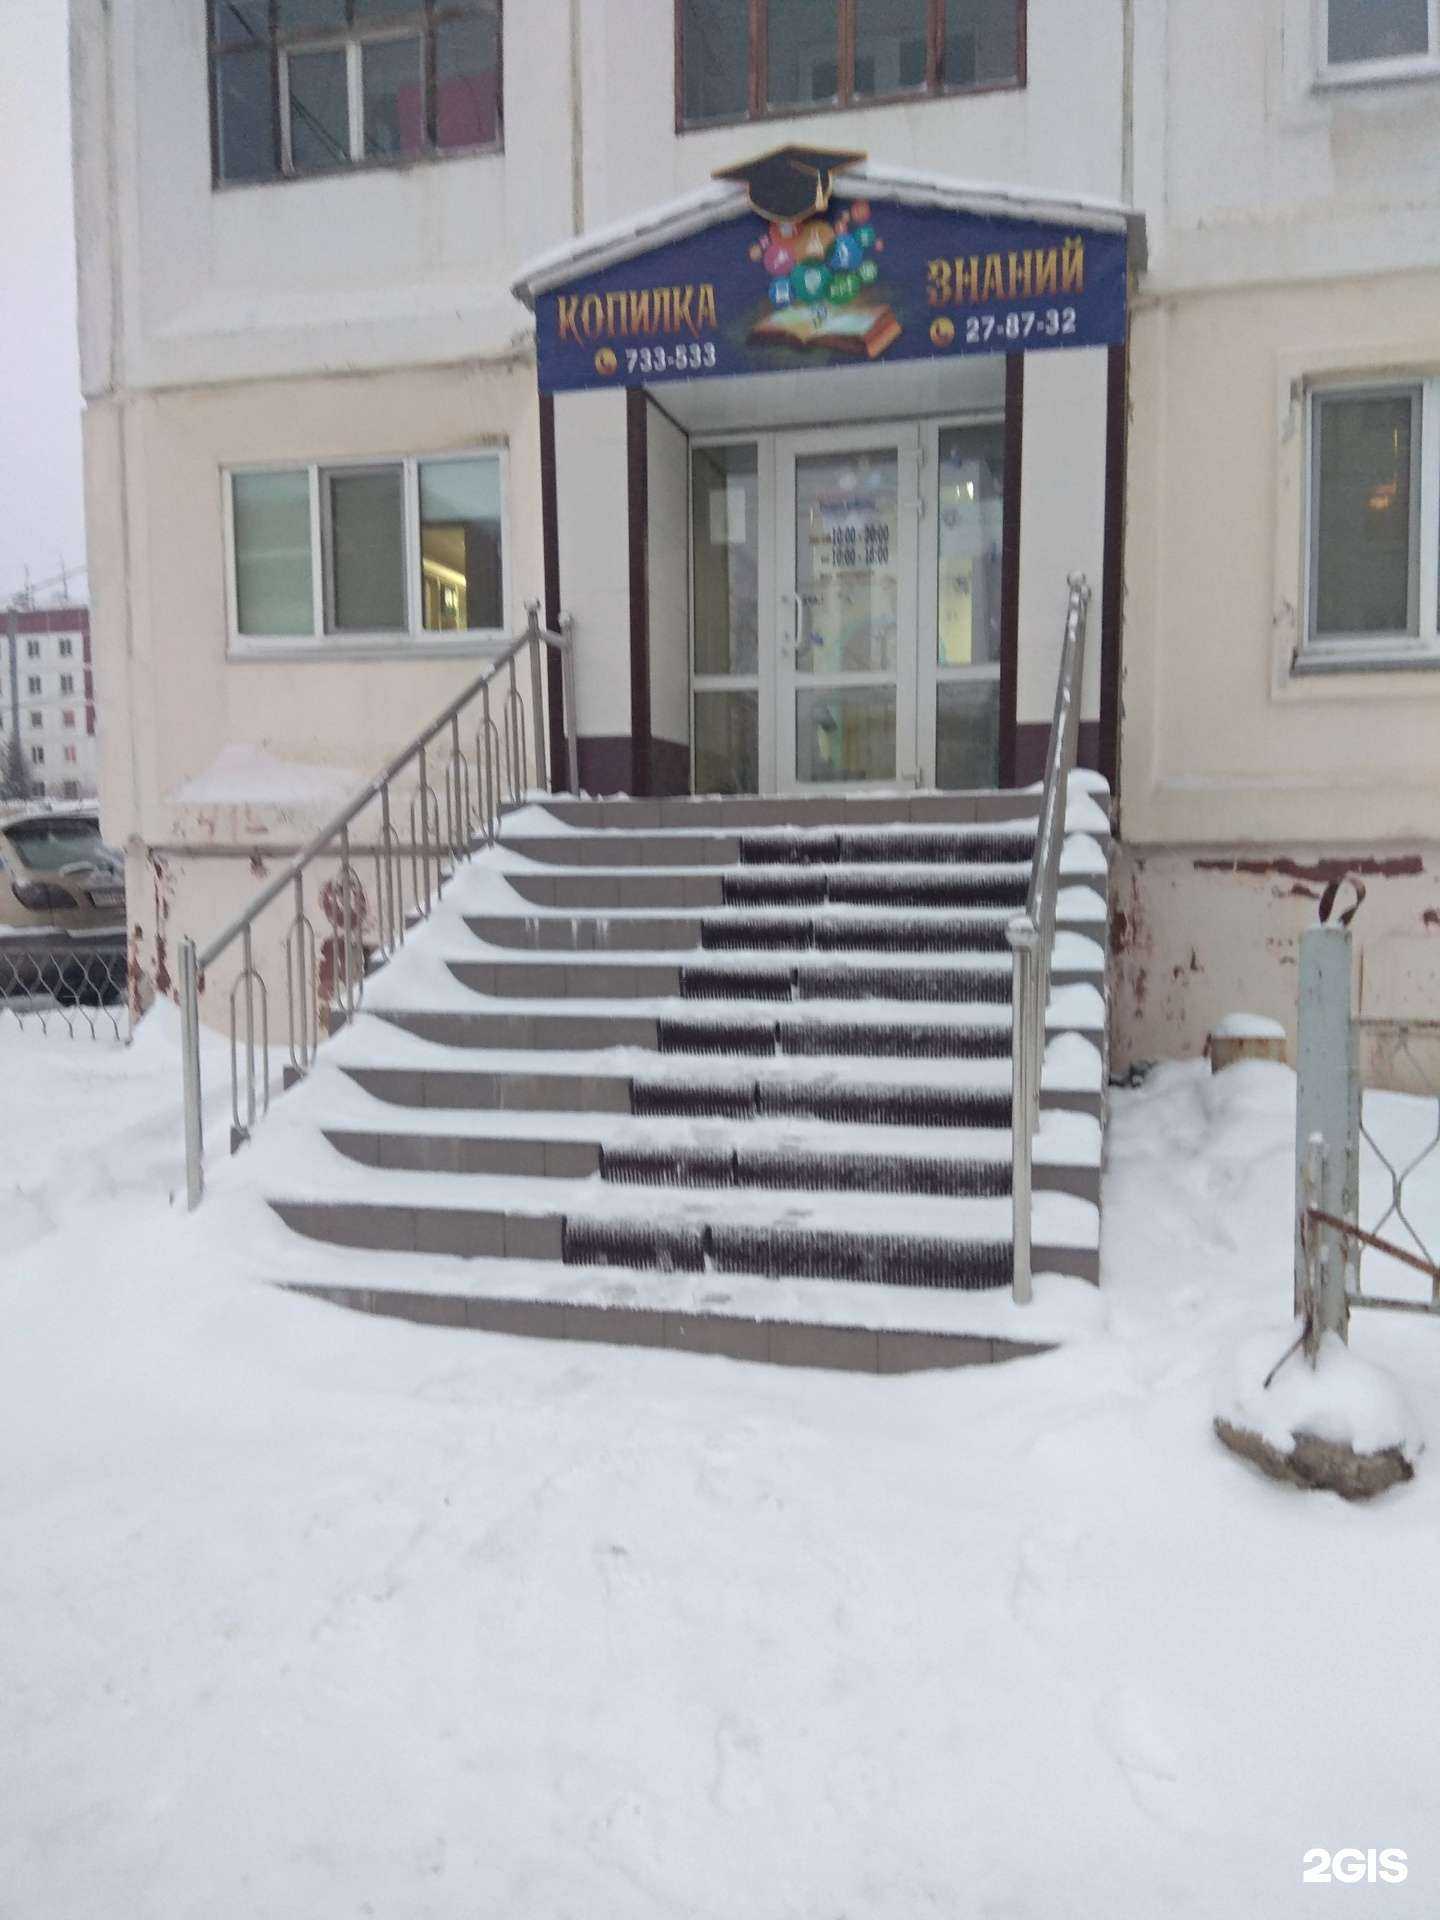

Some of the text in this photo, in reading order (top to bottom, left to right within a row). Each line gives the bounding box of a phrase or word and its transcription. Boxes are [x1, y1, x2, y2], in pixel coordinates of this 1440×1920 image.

[557, 237, 1084, 348] КОПИЛКА ЗНАНИЙ
[966, 308, 1076, 343] 27-87-32
